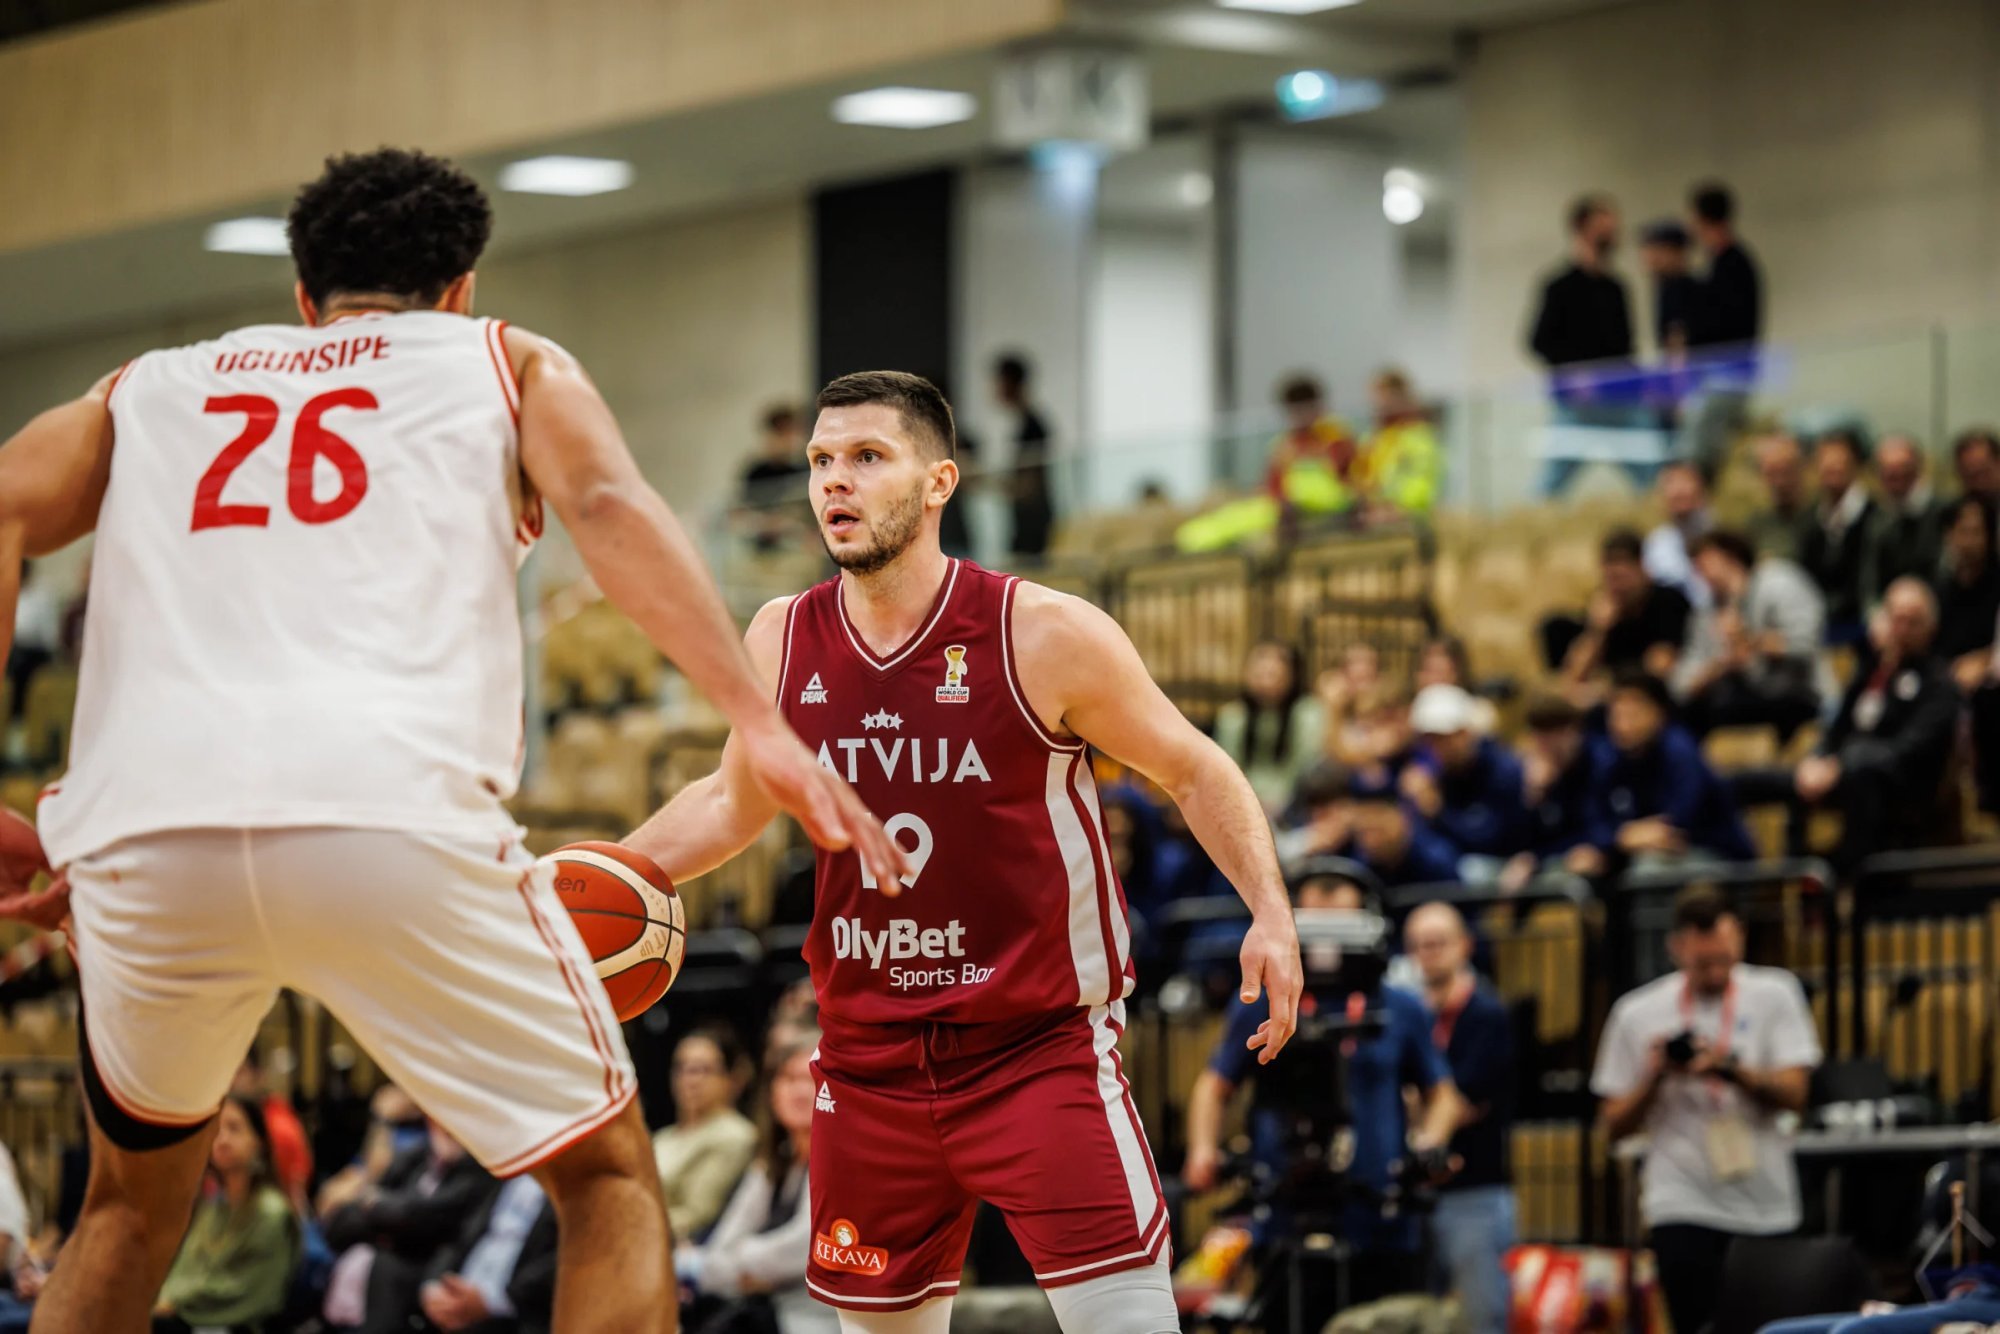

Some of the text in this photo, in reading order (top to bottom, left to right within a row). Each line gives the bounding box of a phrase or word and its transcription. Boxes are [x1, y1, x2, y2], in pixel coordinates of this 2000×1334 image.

[190, 387, 380, 533] 26
[800, 690, 829, 704] PEAK
[816, 738, 992, 783] ATVIJA
[889, 963, 996, 991] Sports Bar
